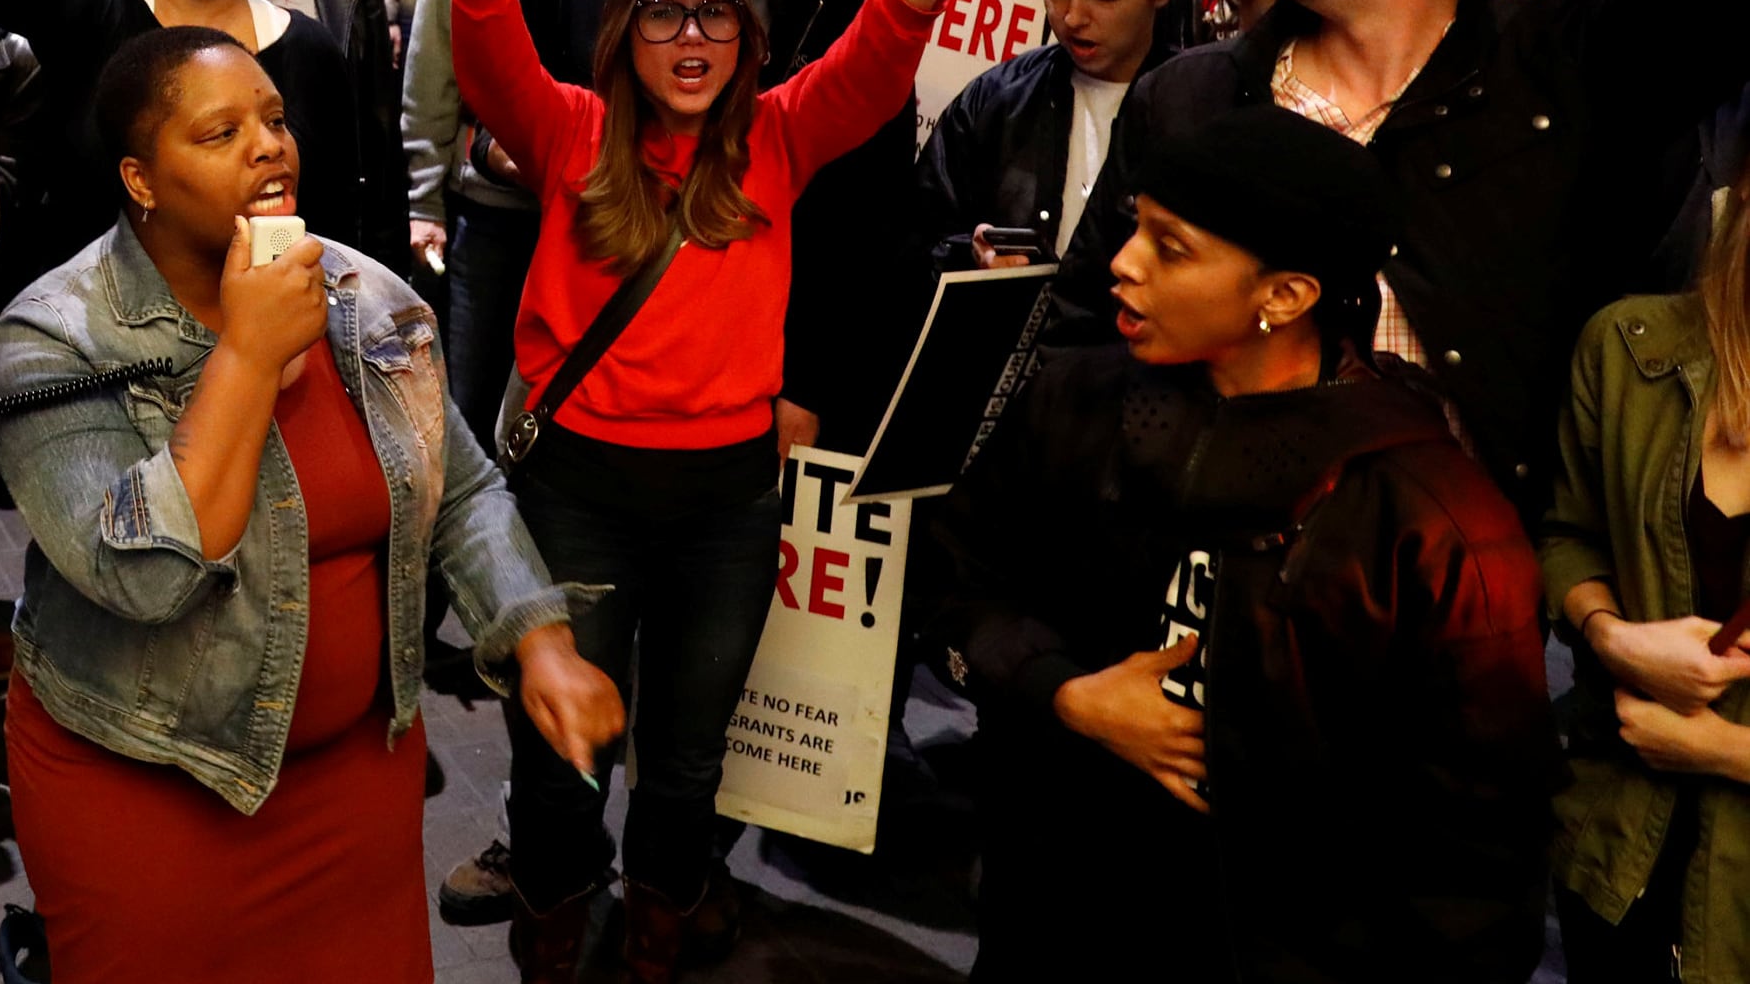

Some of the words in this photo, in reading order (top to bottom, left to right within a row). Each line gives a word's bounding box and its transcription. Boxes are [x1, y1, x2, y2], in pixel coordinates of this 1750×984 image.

[763, 694, 790, 714] NO
[794, 701, 840, 728] FEAR
[799, 731, 835, 754] ARE
[777, 751, 823, 778] HERE
